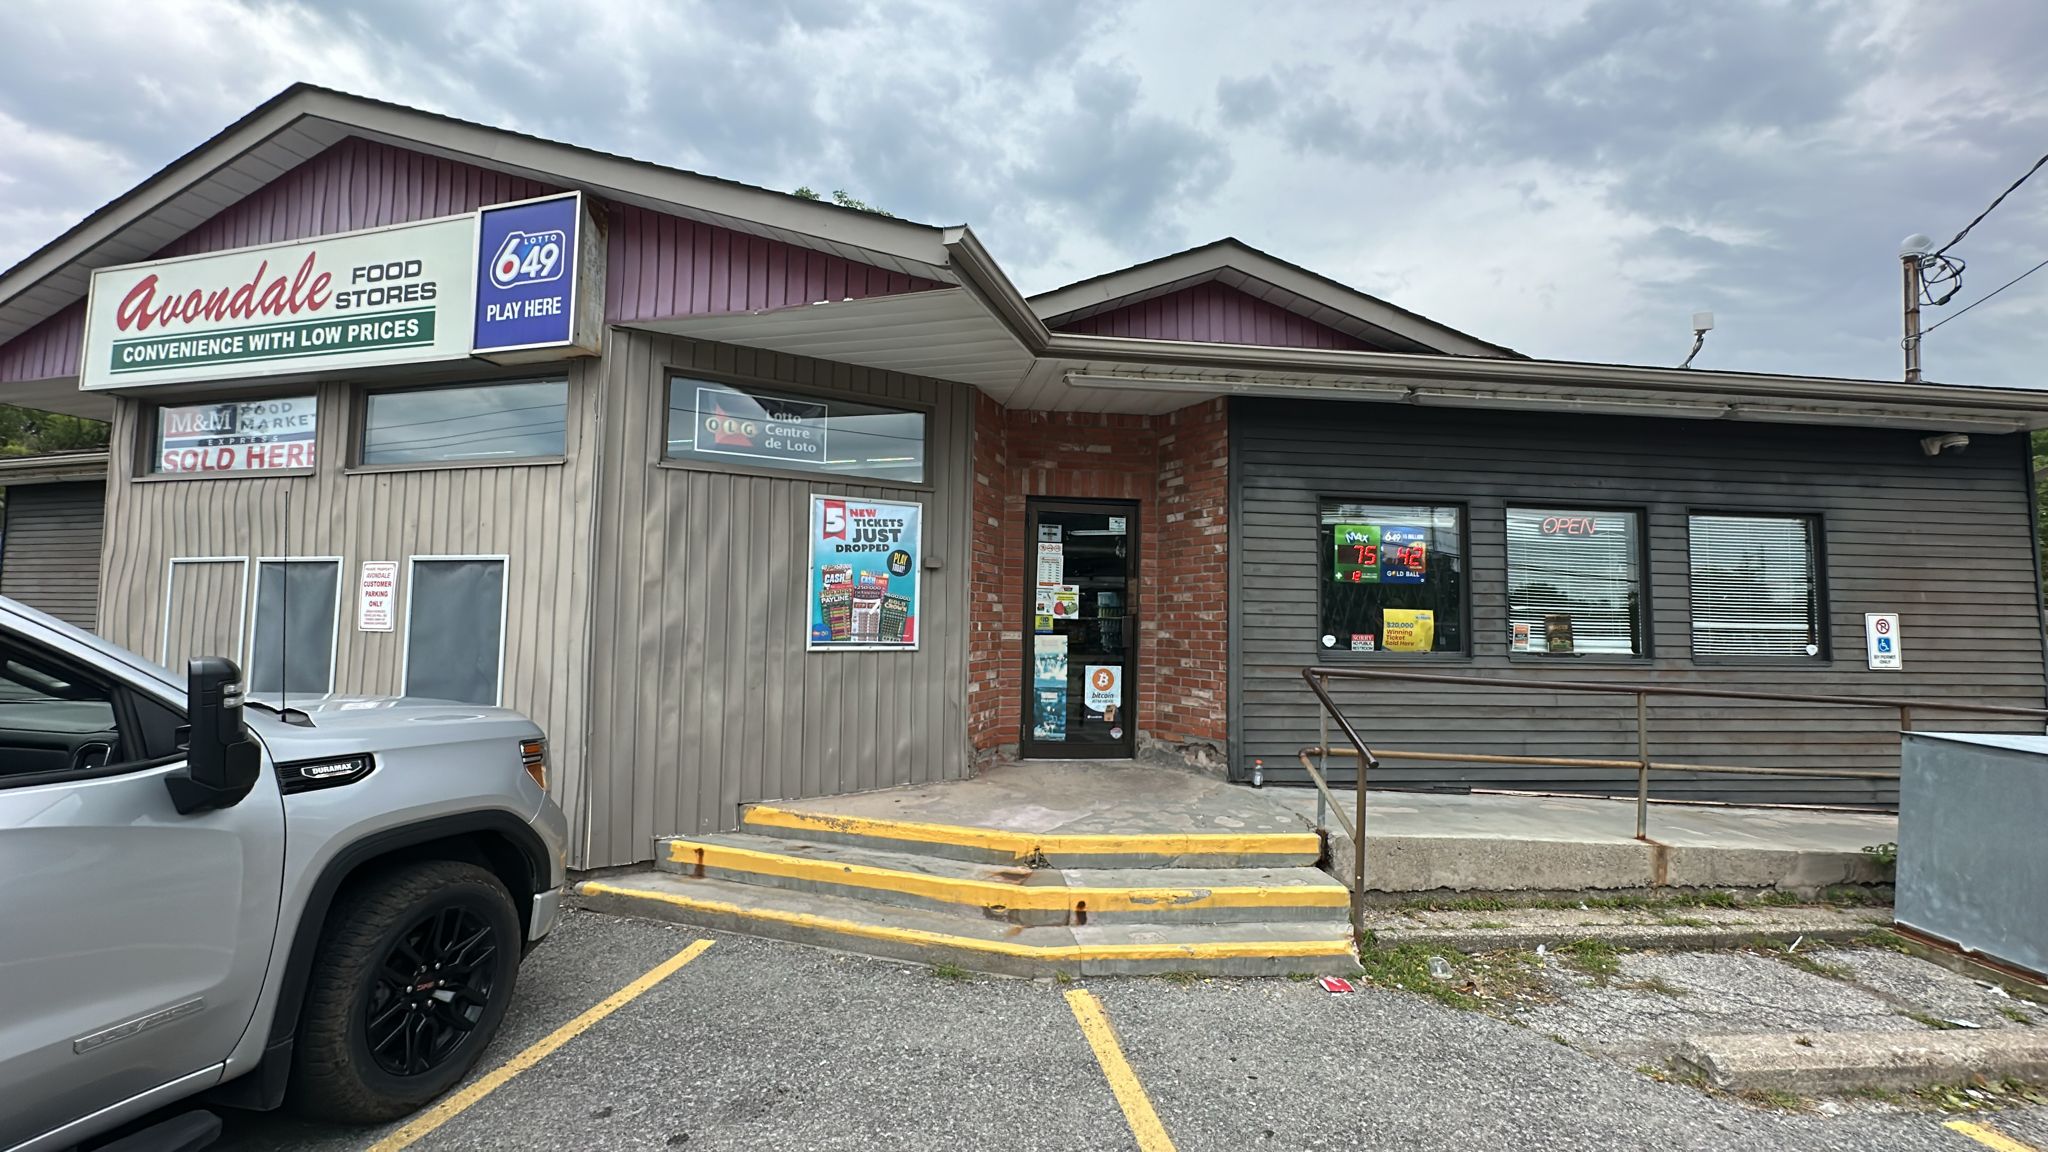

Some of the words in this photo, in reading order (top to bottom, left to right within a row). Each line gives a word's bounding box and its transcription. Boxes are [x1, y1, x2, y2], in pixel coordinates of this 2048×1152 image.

[524, 234, 557, 245] LOTTO
[496, 238, 559, 282] 649
[352, 260, 422, 284] FOOD
[117, 251, 333, 331] Avondale
[336, 282, 436, 309] STORES
[487, 302, 521, 322] PLAY
[524, 297, 562, 318] HERE
[123, 336, 243, 363] CONVENIENCE
[249, 331, 295, 351] WITH
[301, 326, 342, 346] LOW
[348, 319, 419, 342] PRICES
[240, 402, 293, 416] FOOD
[765, 409, 801, 424] Lotto
[171, 409, 231, 433] M&M
[706, 418, 756, 437] OLG
[765, 424, 810, 439] Centre
[208, 435, 279, 446] EXPRESS
[765, 438, 782, 449] de
[787, 440, 817, 453] Loto
[163, 447, 235, 472] SOLD
[825, 507, 845, 533] 5
[849, 509, 876, 517] NEW
[854, 519, 904, 527] TICKETS
[1543, 517, 1597, 534] OPEN
[852, 528, 902, 543] JUST
[836, 544, 890, 552] DROPPED
[1354, 545, 1377, 565] 75
[1397, 545, 1423, 566] 42
[894, 552, 908, 565] PLAY
[824, 573, 845, 584] CASH
[821, 595, 849, 603] PAYLINE
[312, 763, 352, 774] DURAMAX
